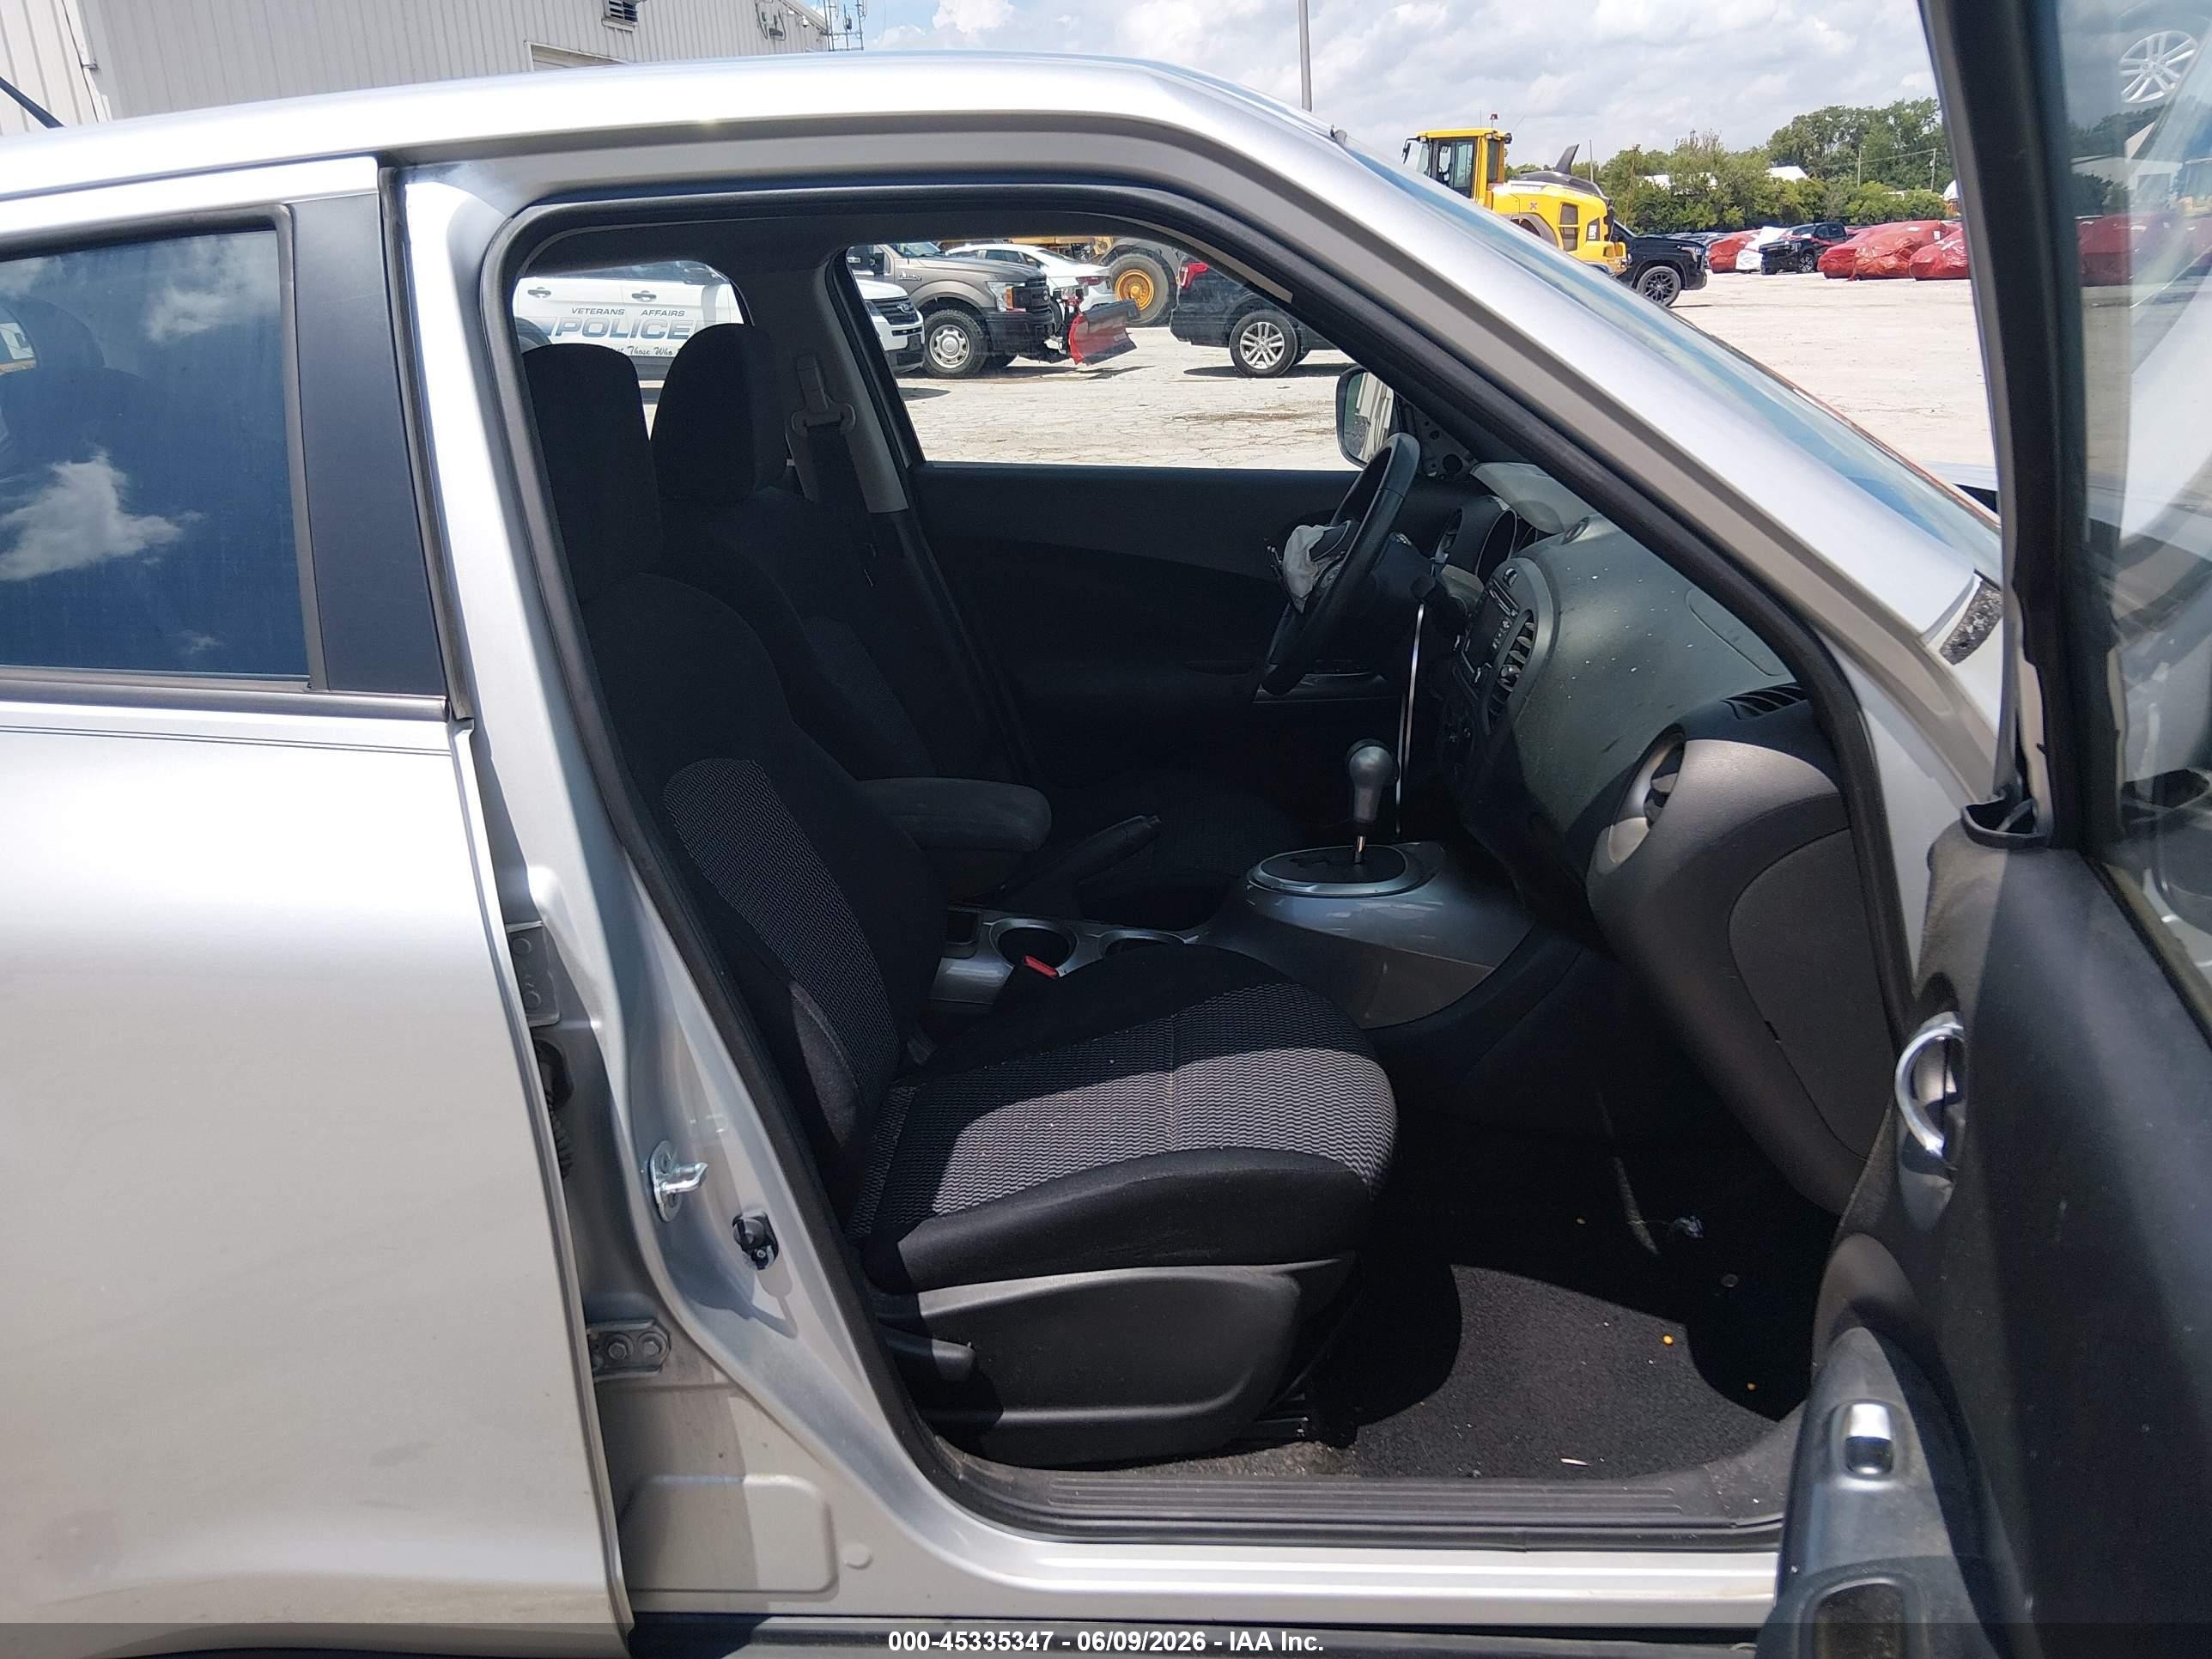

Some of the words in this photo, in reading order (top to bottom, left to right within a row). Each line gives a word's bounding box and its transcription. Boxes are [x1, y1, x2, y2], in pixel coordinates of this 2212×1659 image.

[571, 307, 625, 316] VETERANS
[556, 317, 693, 340] POLICE
[627, 345, 650, 356] Those
[653, 346, 673, 356] Who
